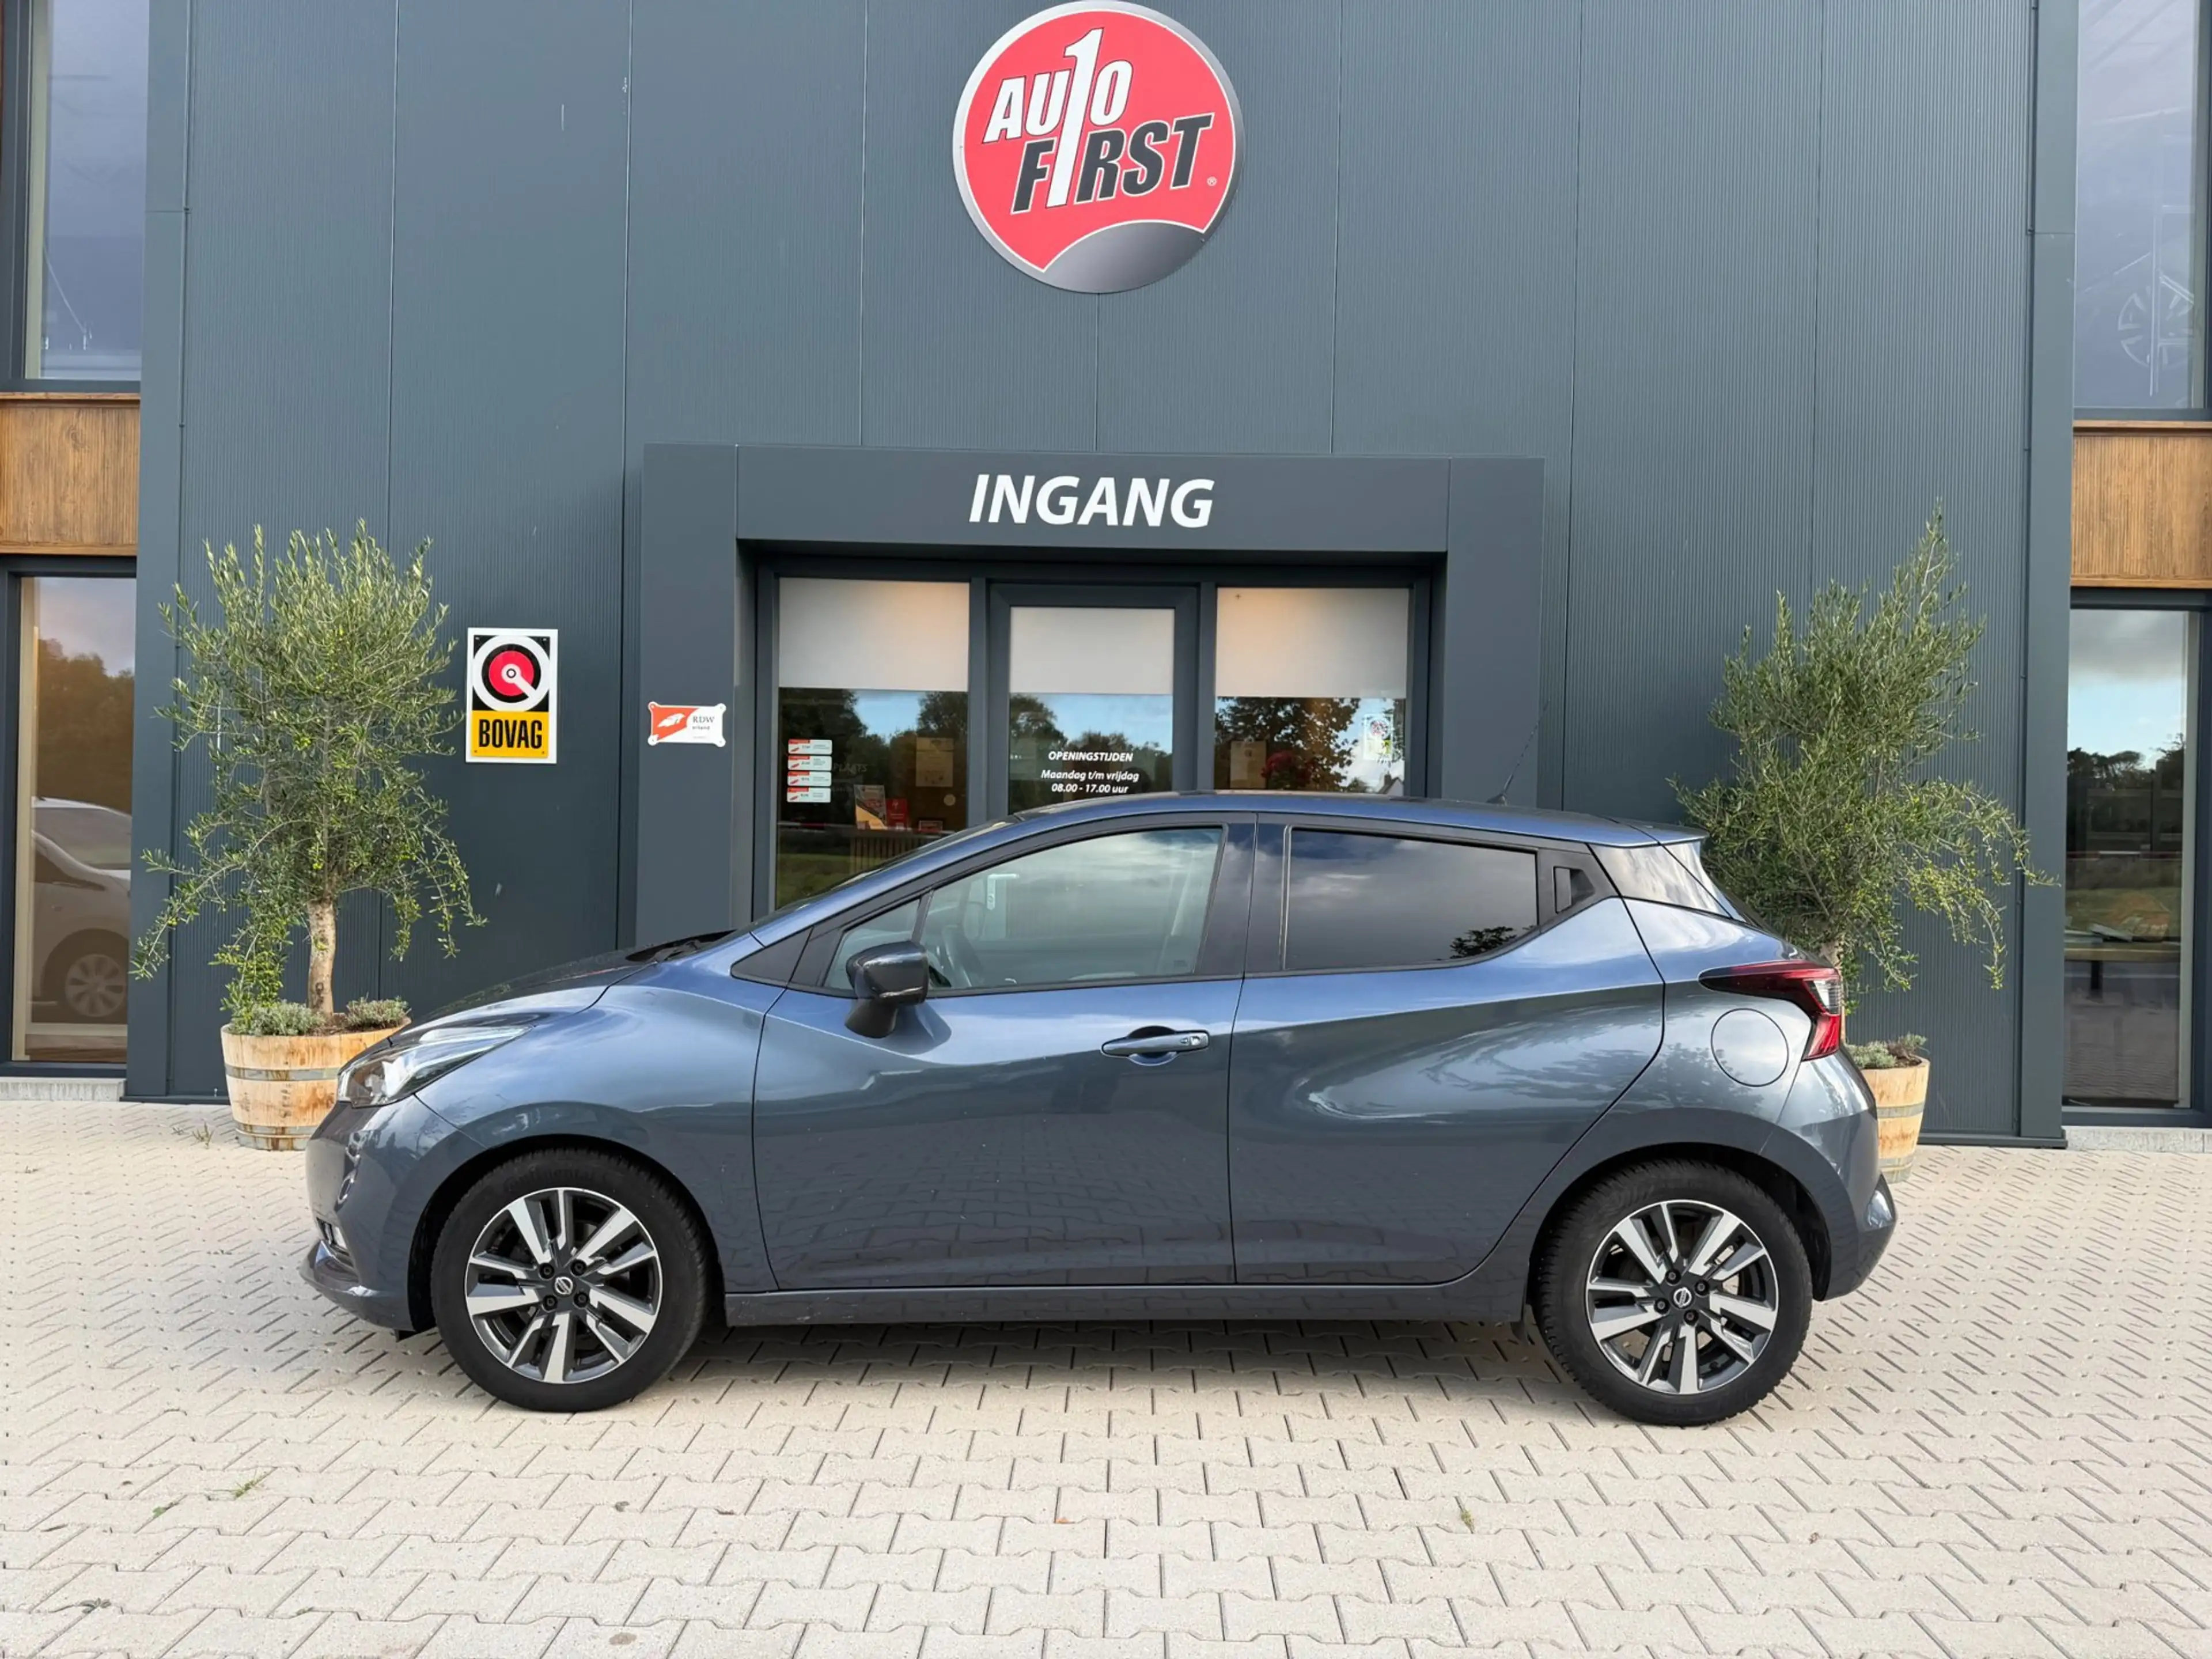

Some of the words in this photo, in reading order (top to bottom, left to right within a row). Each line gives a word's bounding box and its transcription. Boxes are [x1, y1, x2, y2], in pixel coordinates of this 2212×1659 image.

[969, 474, 1215, 528] INGANG
[478, 719, 543, 748] BOVAG
[1048, 751, 1134, 761] OPENINGSTIJDEN
[1041, 770, 1086, 781] Maandag
[1088, 771, 1104, 780] t/m
[1106, 771, 1139, 782] vrijdag
[1051, 783, 1078, 793] 08.00
[1085, 784, 1111, 793] 17.00
[1112, 785, 1128, 793] uur
